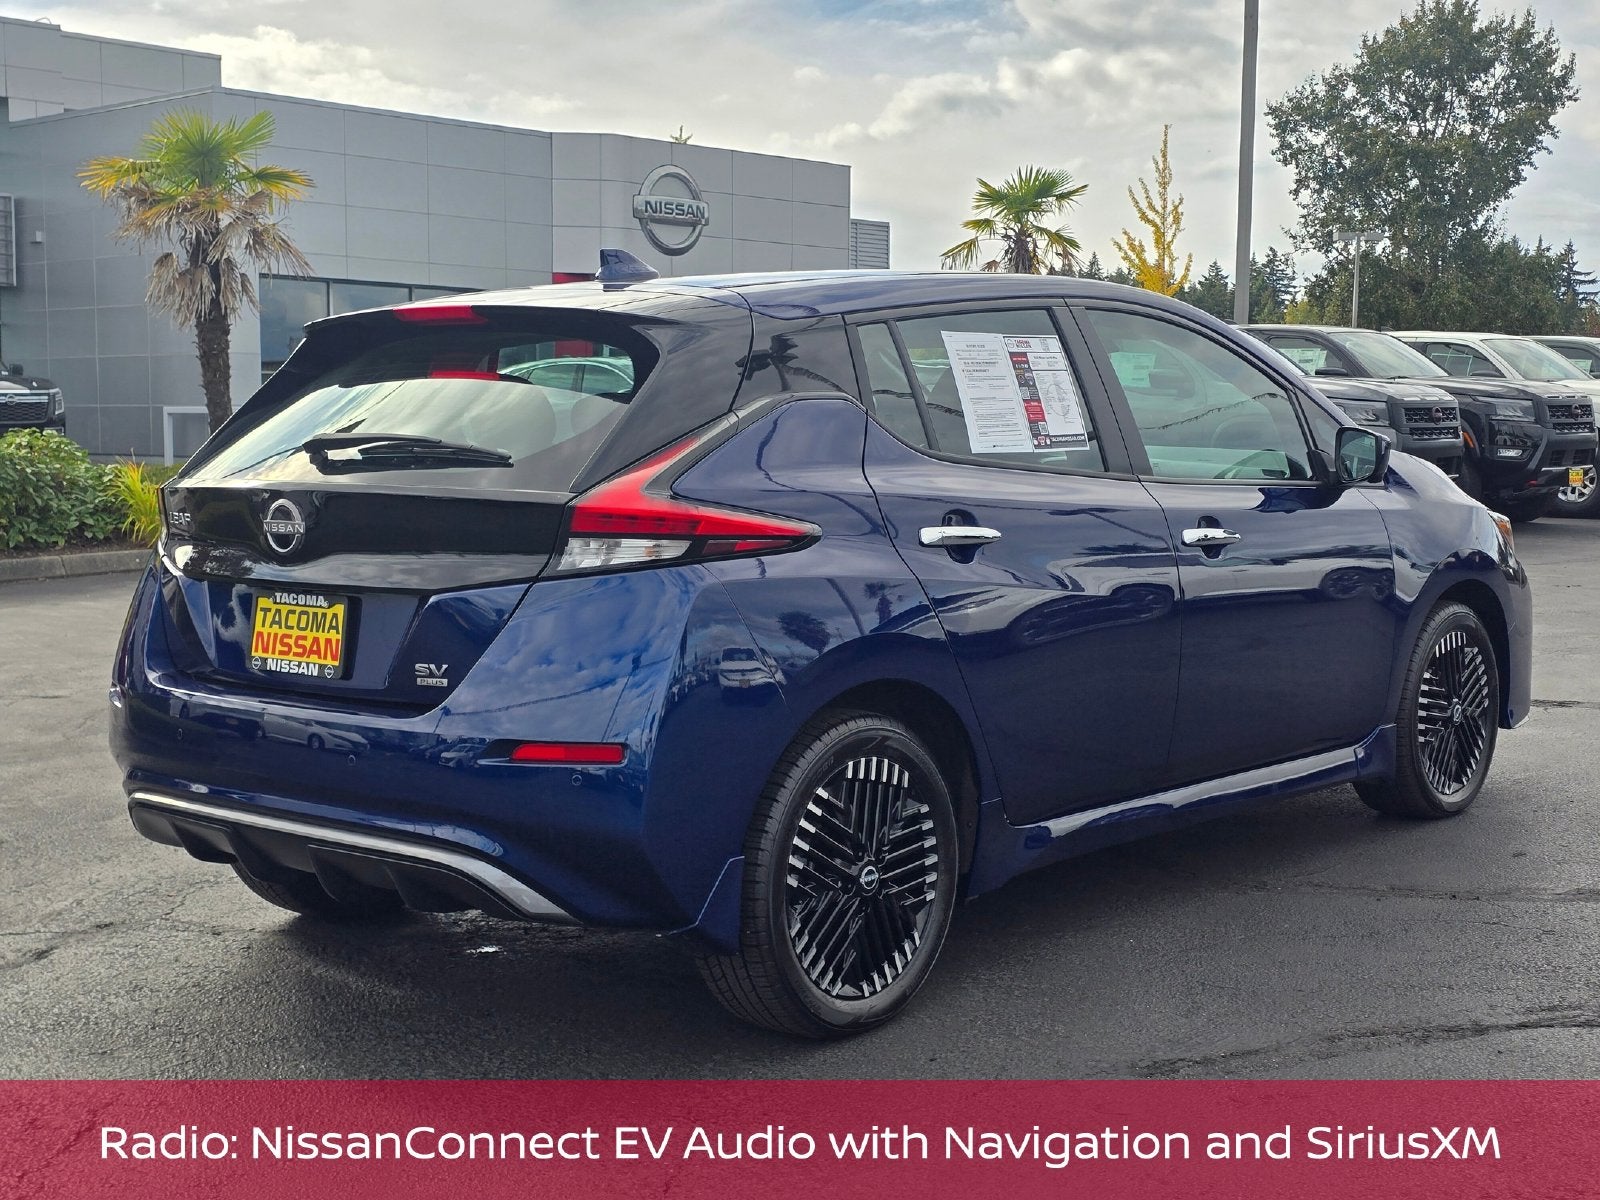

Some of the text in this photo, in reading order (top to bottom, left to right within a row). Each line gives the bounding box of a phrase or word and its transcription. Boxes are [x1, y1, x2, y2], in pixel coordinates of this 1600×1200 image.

[644, 200, 706, 219] NISSAN
[263, 522, 304, 533] NISSAN
[274, 592, 325, 607] TACOMA
[260, 607, 340, 635] TACOMA
[253, 630, 341, 662] NISSAN
[266, 658, 319, 677] NISSAN
[414, 663, 449, 677] SV
[419, 678, 445, 686] PLUS
